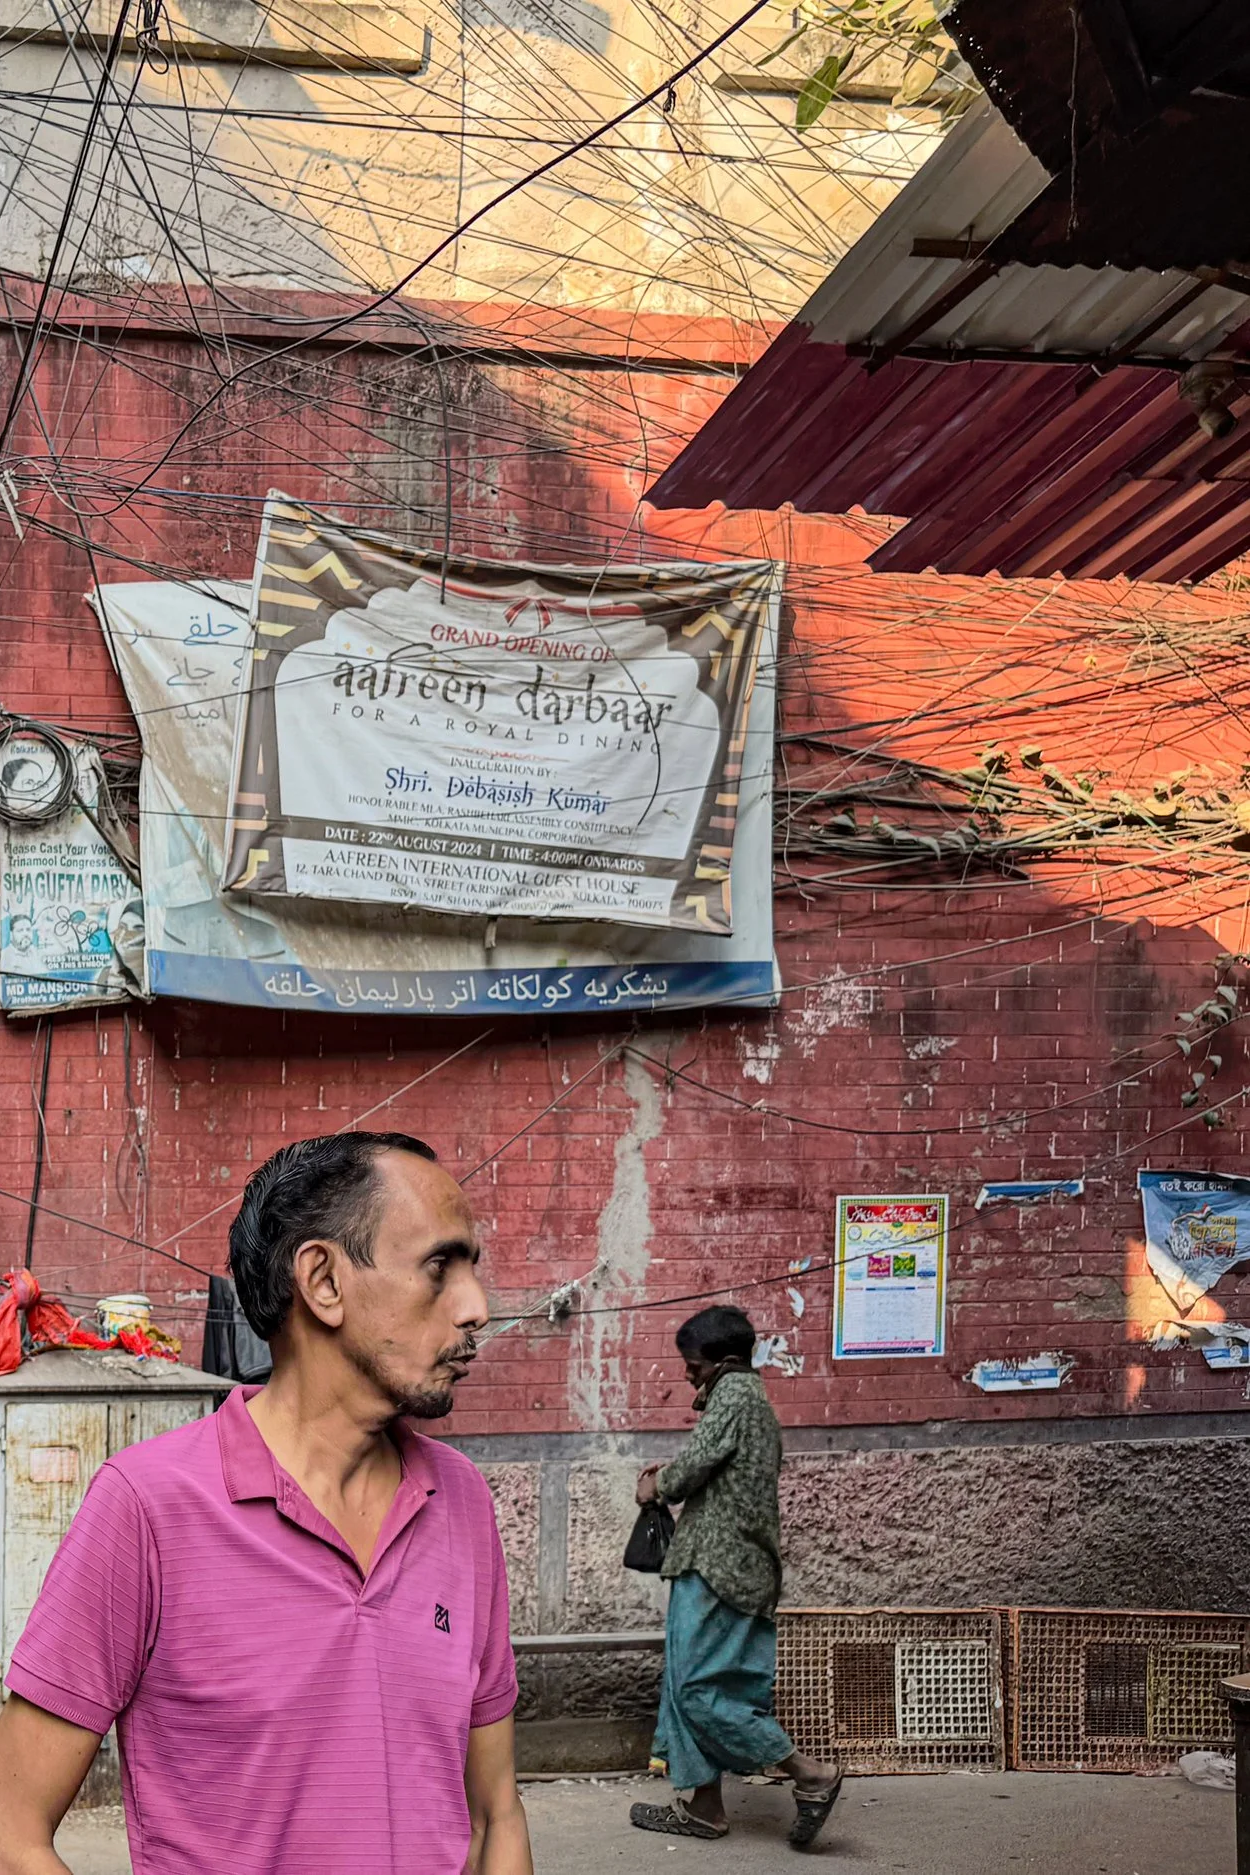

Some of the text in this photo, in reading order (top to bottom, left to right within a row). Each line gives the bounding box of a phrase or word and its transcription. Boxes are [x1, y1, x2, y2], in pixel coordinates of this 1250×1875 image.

[430, 623, 499, 648] GRAND
[504, 633, 587, 662] OPENING
[332, 642, 673, 734] aafreen darbaar
[332, 702, 385, 721] FOR
[409, 714, 421, 726] A
[446, 717, 534, 742] ROYAL
[451, 756, 535, 776] INAUGURATION
[348, 794, 419, 812] HONOURABLE
[384, 766, 612, 816] Shri. Debasish Kumar
[473, 821, 525, 837] MUNICIPAL
[528, 829, 595, 845] CORPORATION
[4, 843, 37, 854] Please
[39, 843, 63, 855] Cast
[65, 844, 88, 856] Your
[8, 856, 57, 867] Trinamool
[60, 856, 107, 870] Congress
[325, 826, 359, 842] DATE
[394, 836, 448, 853] AUGUST
[451, 842, 482, 857] 2024
[501, 845, 534, 862] TIME
[584, 855, 646, 872] ONWARDS
[3, 871, 86, 902] SHAGUFTA
[311, 864, 340, 877] TARA
[343, 869, 383, 882] CHAND
[423, 878, 464, 893] STREET
[324, 849, 642, 895] AAFREEN INTERNATIONAL GUEST HOUSE
[6, 984, 25, 996] MD
